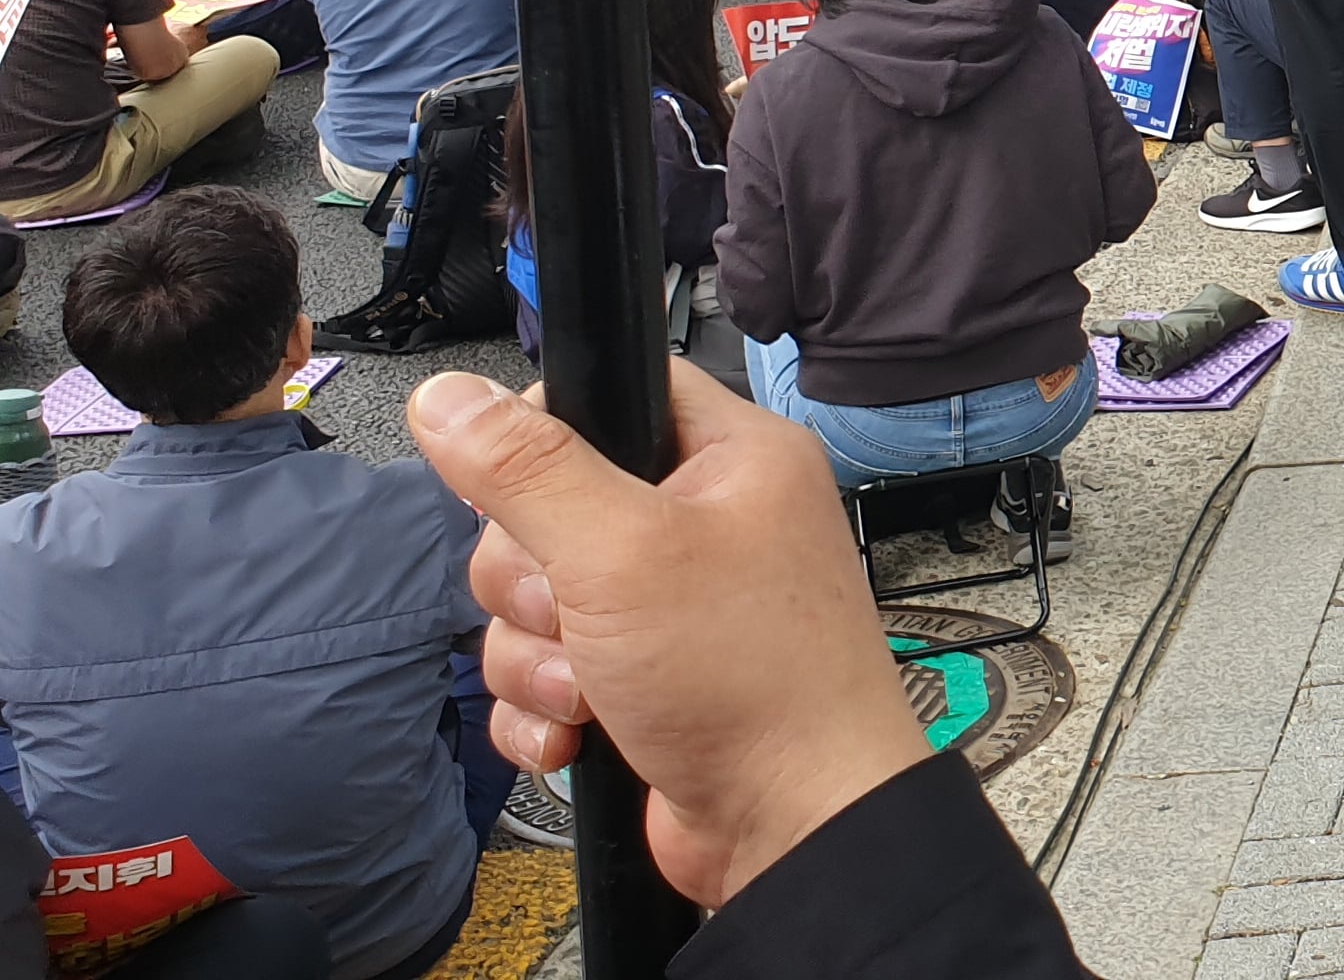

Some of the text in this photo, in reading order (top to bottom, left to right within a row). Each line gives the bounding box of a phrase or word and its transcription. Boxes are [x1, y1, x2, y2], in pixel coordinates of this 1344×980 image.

[746, 15, 811, 62] 압도
[1120, 77, 1154, 99] 제정
[40, 850, 174, 897] 지휘
